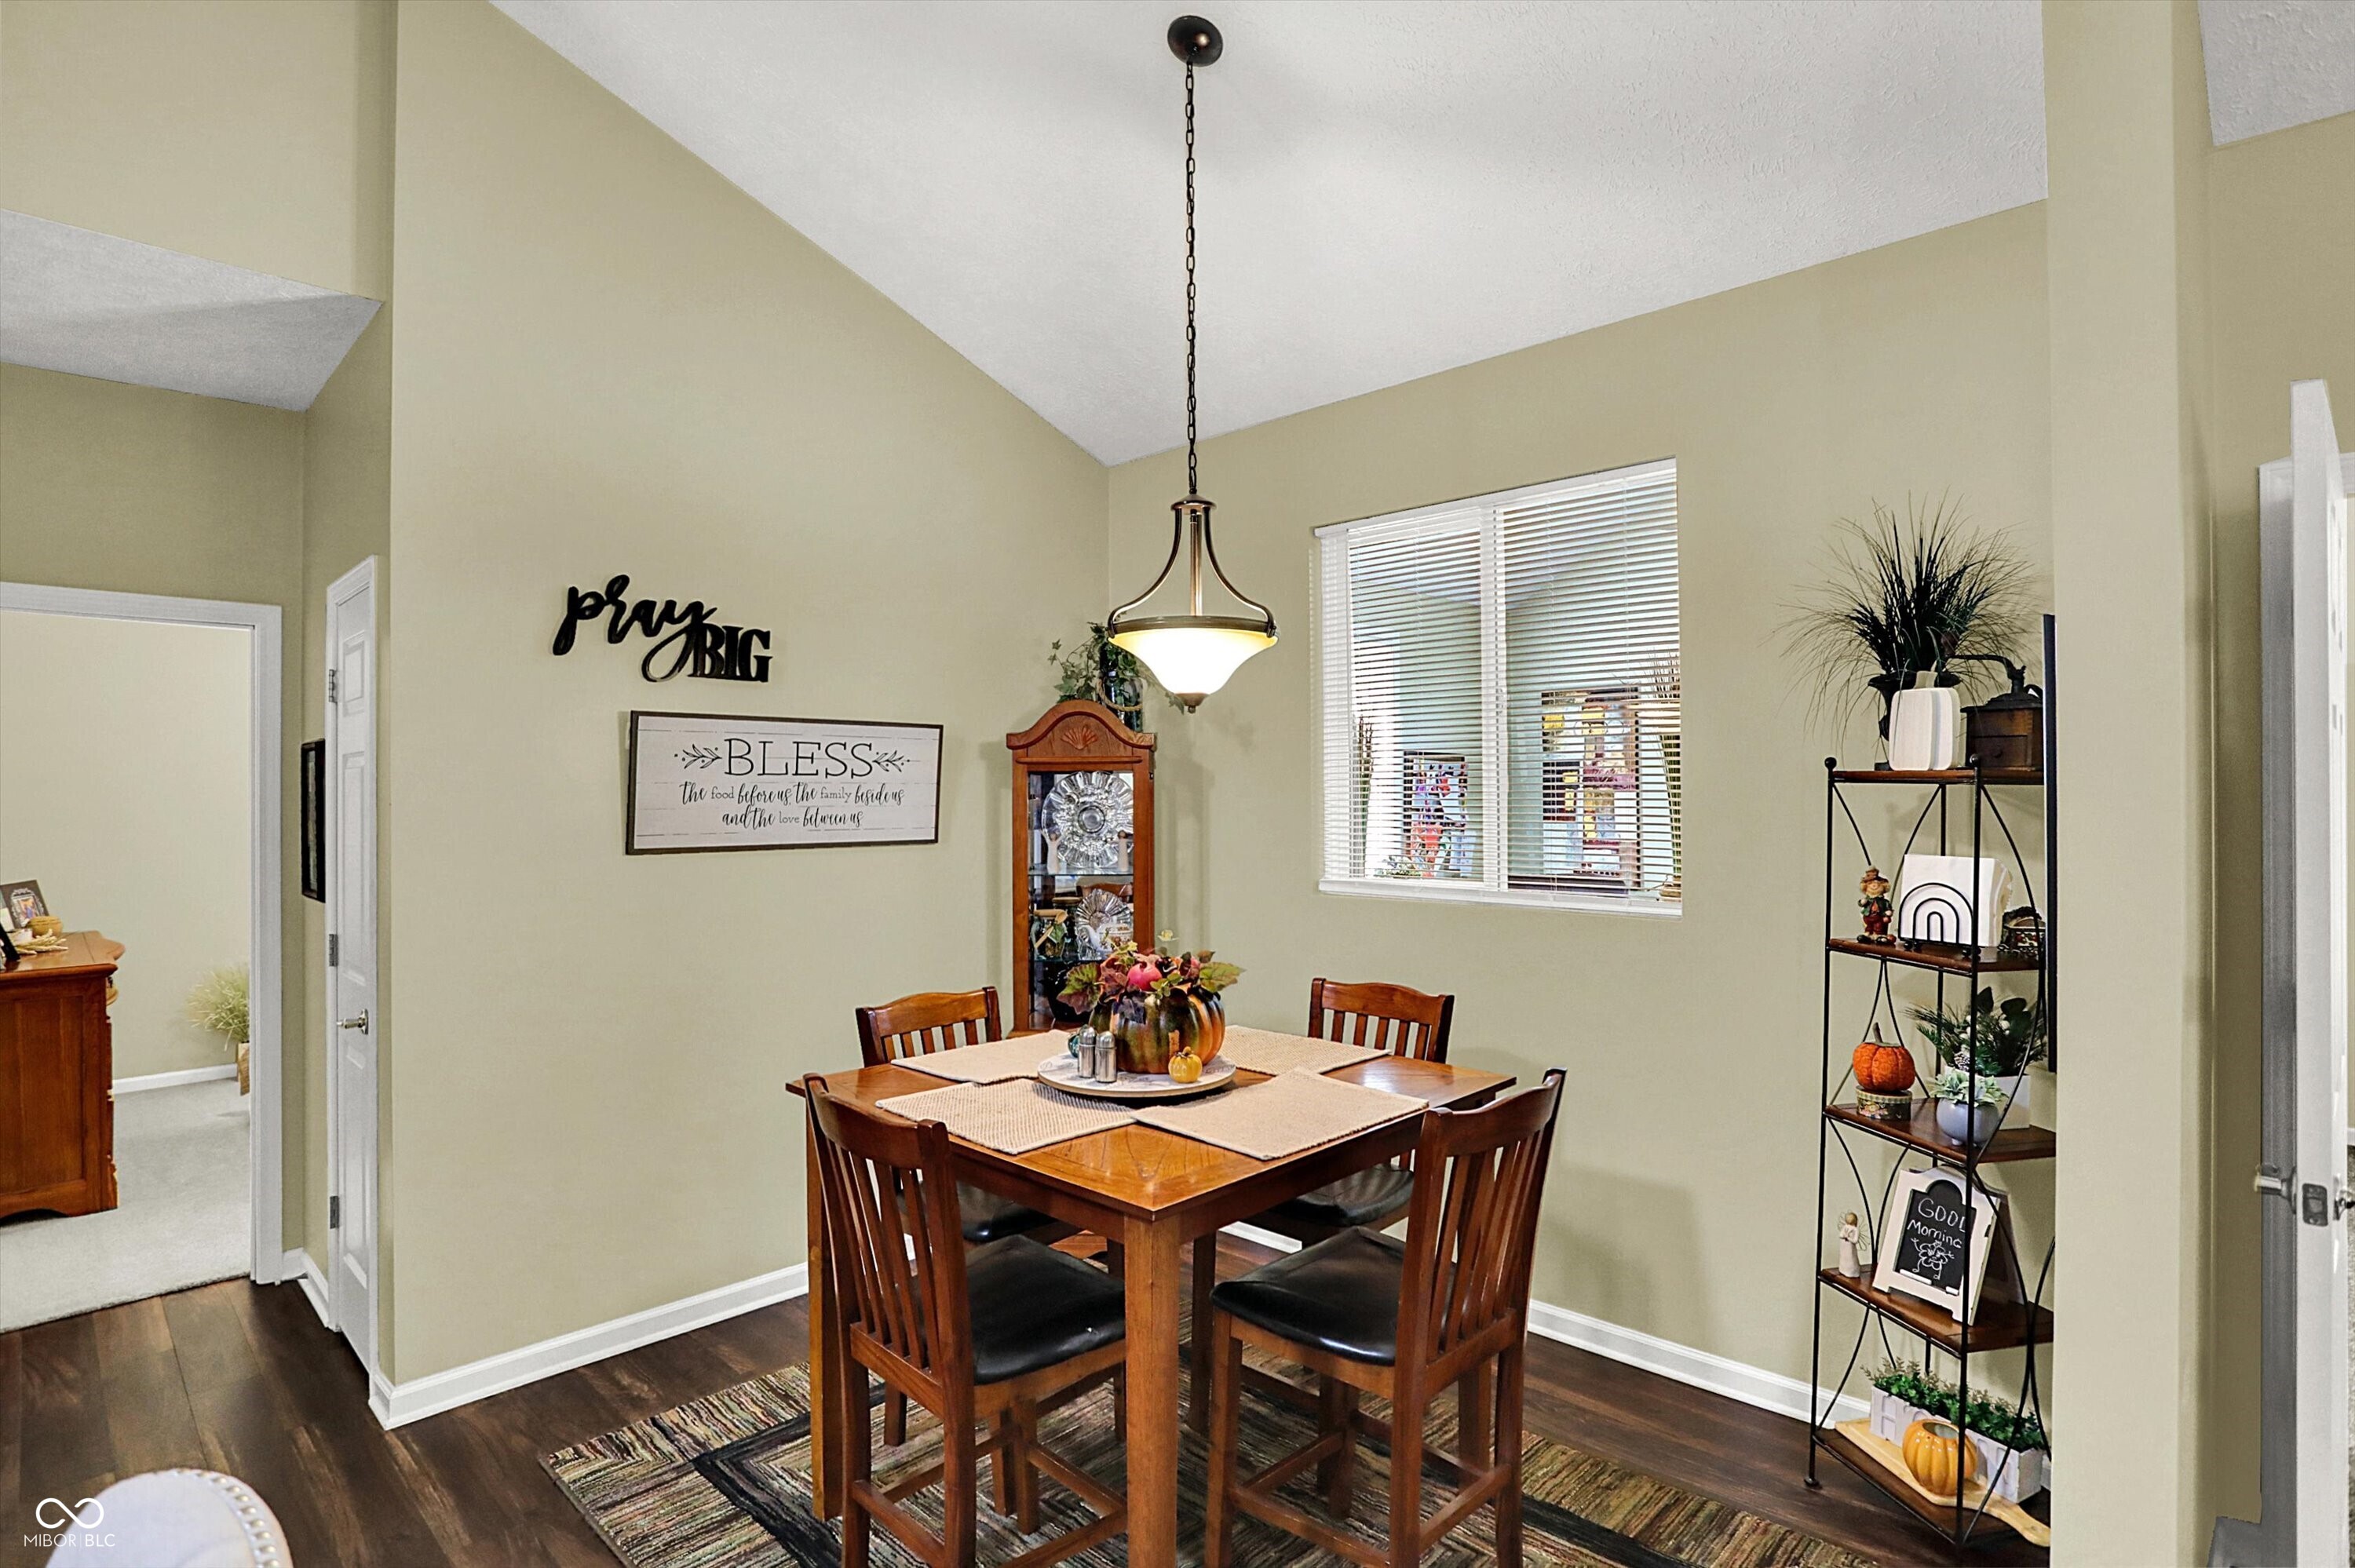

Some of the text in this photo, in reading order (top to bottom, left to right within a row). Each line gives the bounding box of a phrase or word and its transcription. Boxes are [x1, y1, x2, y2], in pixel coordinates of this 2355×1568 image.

[553, 574, 717, 682] pray
[688, 623, 773, 683] BIG
[724, 738, 874, 779] BLESS
[679, 781, 706, 805] the
[711, 786, 734, 799] food
[738, 783, 776, 806] before
[793, 782, 817, 804] the
[820, 786, 852, 803] family
[855, 783, 890, 806] beside
[892, 789, 905, 806] us
[722, 804, 751, 829] and
[750, 808, 775, 830] the
[779, 811, 800, 823] love
[803, 807, 849, 828] between
